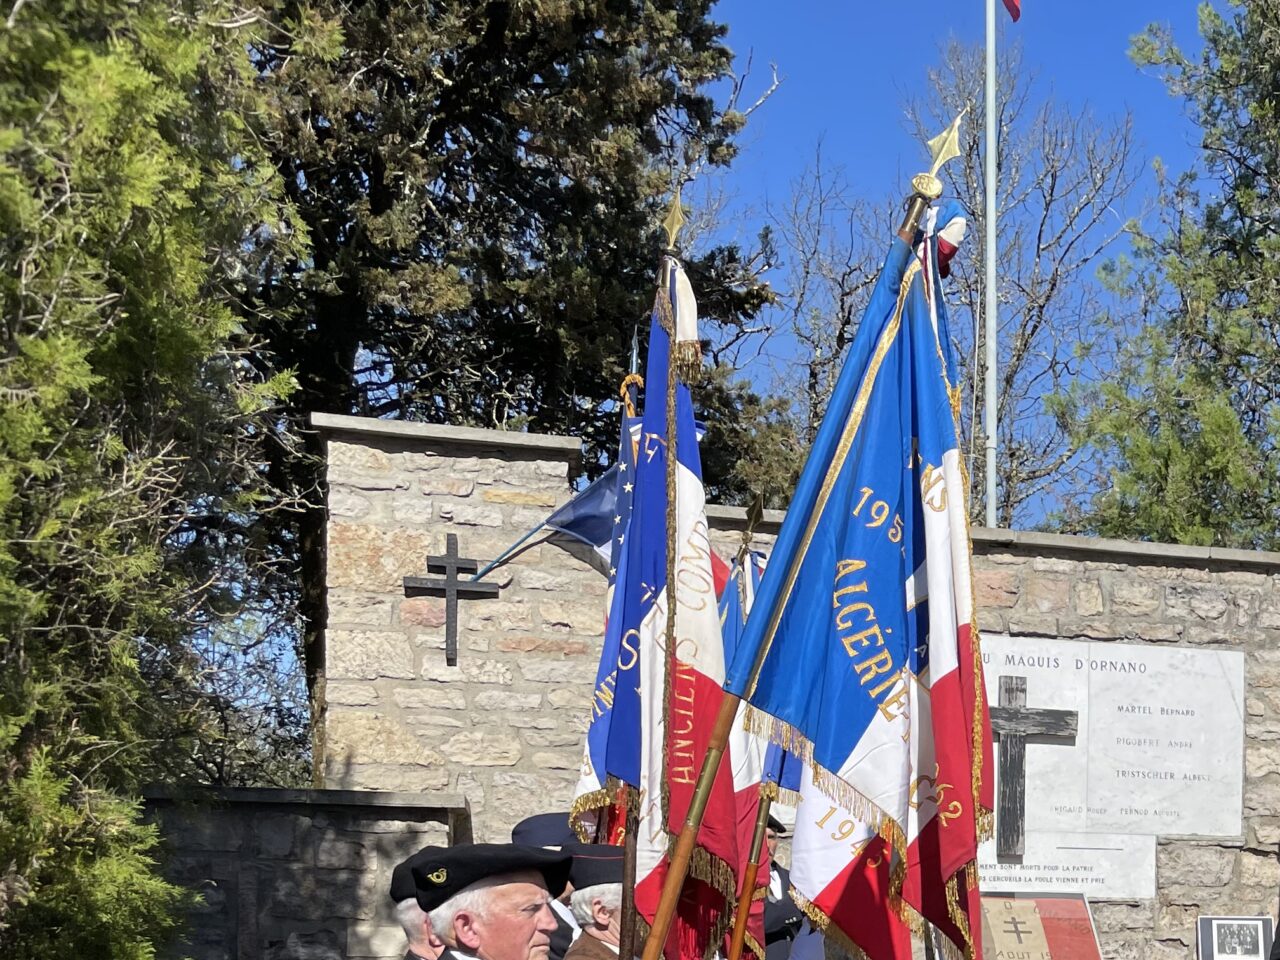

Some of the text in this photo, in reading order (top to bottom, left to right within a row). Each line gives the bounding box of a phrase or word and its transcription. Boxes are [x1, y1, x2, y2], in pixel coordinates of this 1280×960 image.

[833, 558, 911, 722] ALGÉRIE
[1005, 654, 1146, 673] MAQUIS D'ORNANO
[1117, 705, 1195, 716] MARTEL BERNARD
